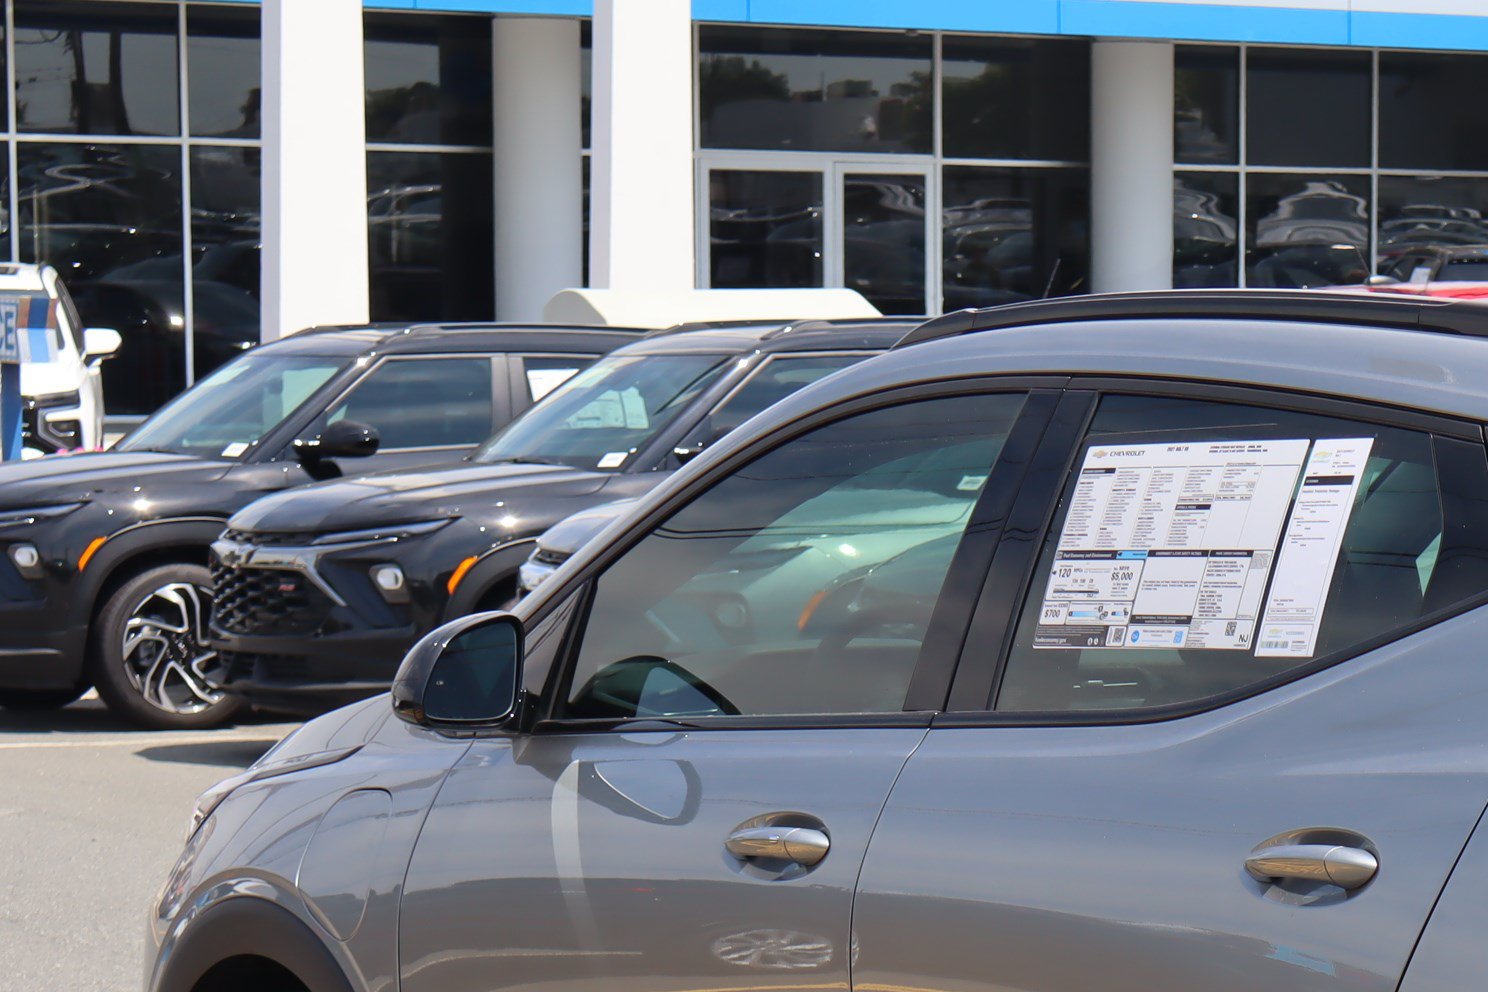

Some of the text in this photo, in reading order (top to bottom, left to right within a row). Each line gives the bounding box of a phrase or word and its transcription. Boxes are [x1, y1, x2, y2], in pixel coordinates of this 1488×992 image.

[1058, 568, 1072, 578] 120
[1110, 571, 1134, 581] $5,000
[1238, 634, 1249, 643] NJ
